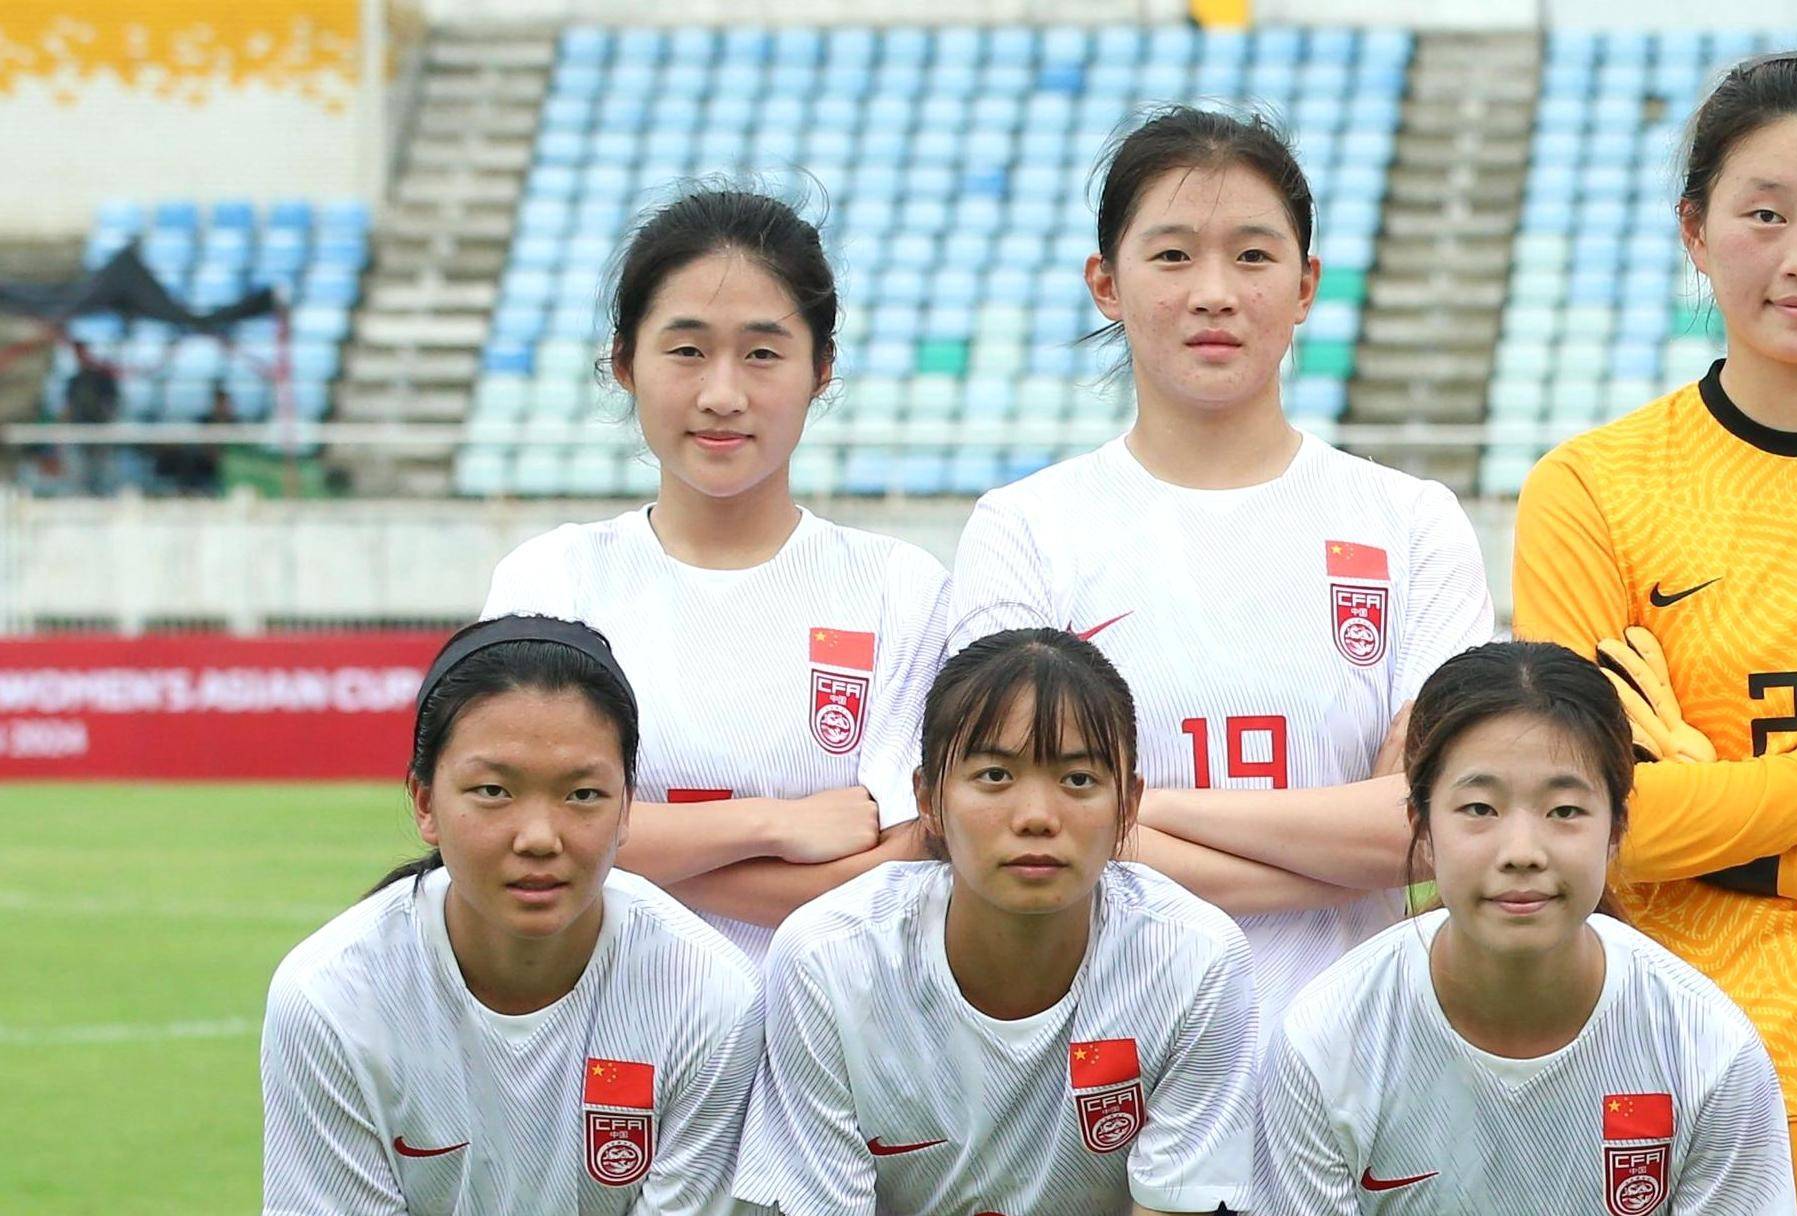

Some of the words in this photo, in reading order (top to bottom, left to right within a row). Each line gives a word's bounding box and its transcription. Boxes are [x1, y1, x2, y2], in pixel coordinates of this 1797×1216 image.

[1338, 592, 1381, 609] CFA
[201, 667, 328, 712] ASIAN
[331, 667, 425, 712] CUP
[817, 677, 862, 699] CFA
[1181, 714, 1288, 789] 19
[1086, 1092, 1134, 1112] CFA
[594, 1118, 643, 1132] CFA
[1614, 1151, 1661, 1169] CFA
